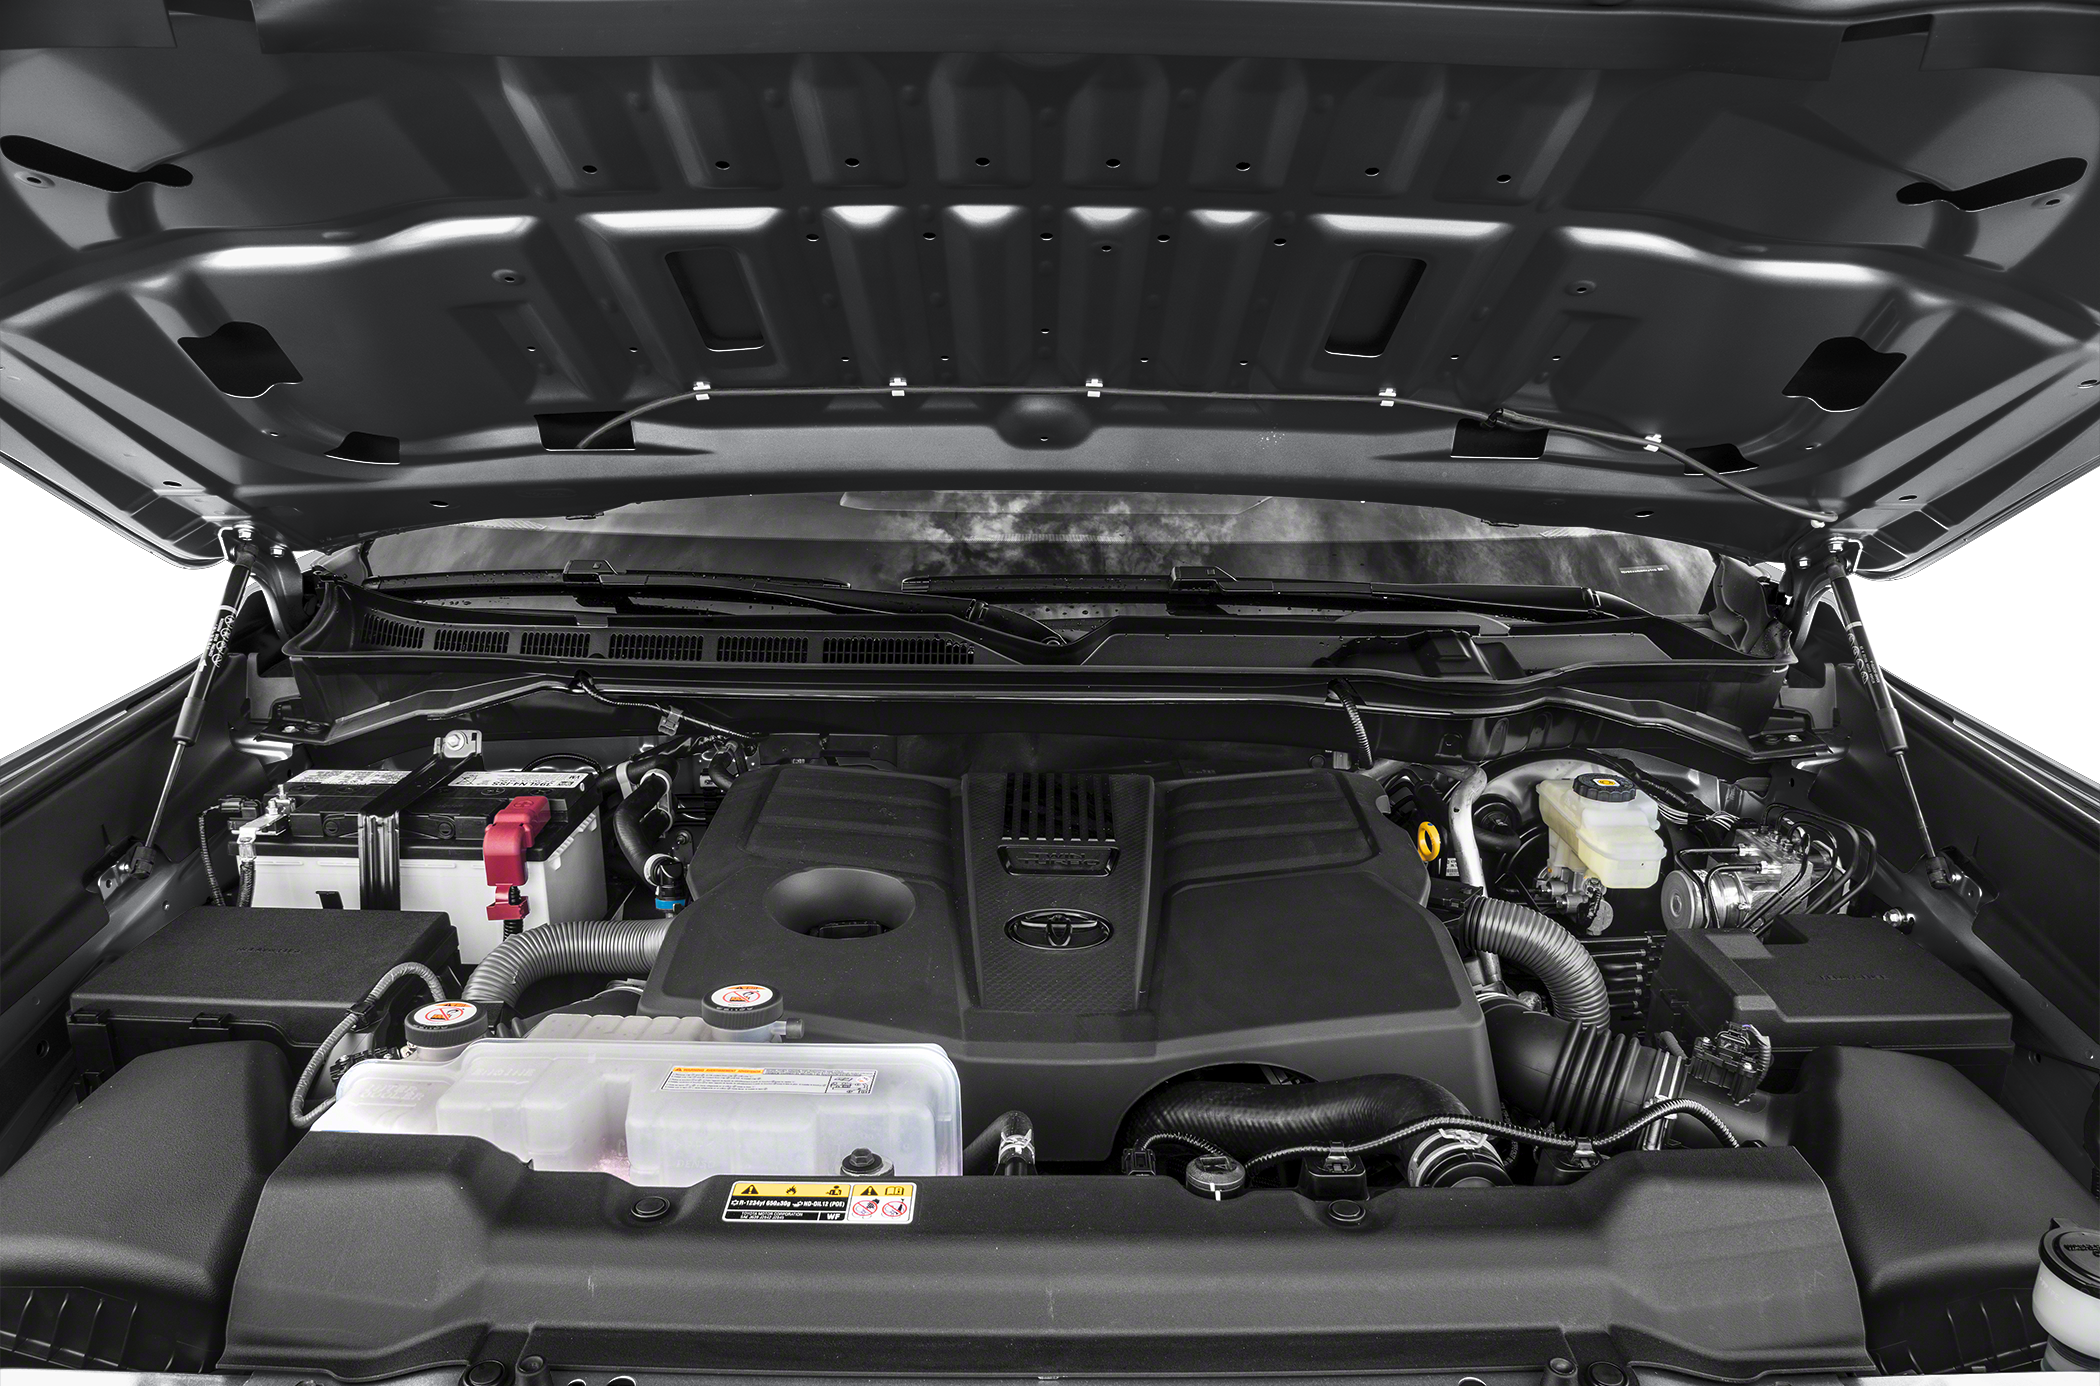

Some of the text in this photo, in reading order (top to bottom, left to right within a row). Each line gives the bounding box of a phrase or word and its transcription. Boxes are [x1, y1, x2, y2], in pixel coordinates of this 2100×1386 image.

[1028, 851, 1086, 859] TWIN
[1016, 857, 1100, 866] TURBO
[675, 1159, 716, 1170] DENSO
